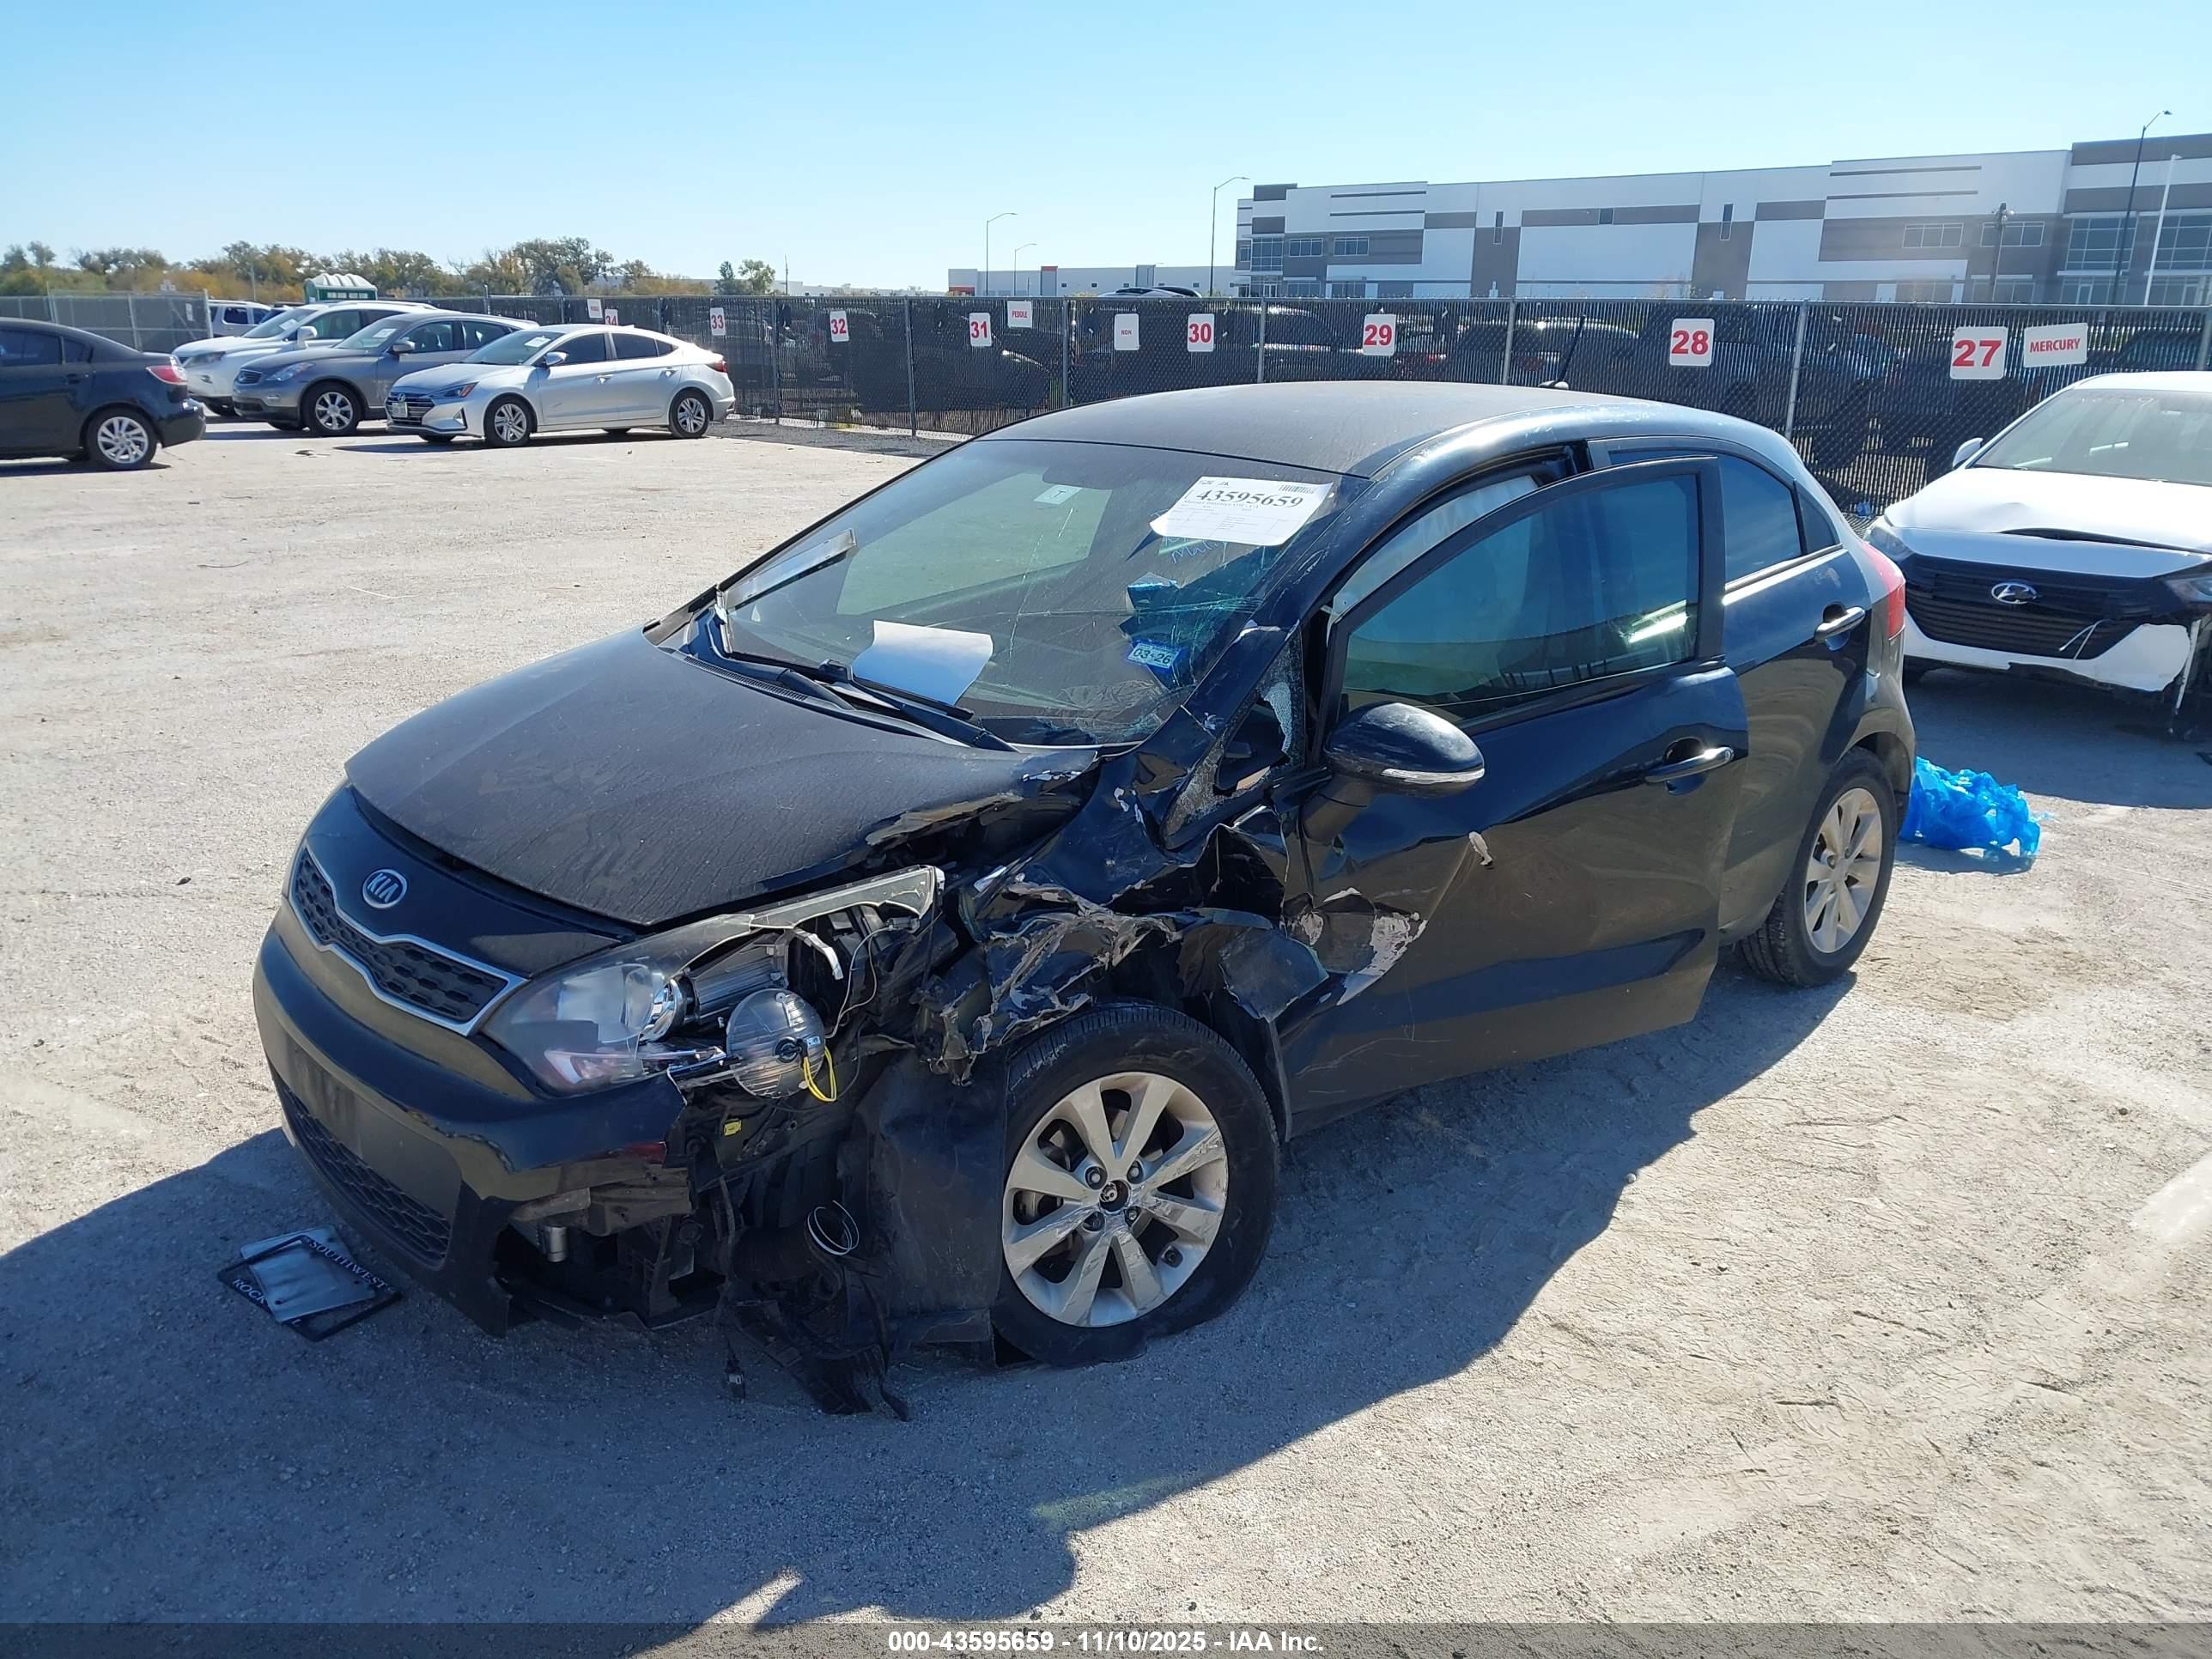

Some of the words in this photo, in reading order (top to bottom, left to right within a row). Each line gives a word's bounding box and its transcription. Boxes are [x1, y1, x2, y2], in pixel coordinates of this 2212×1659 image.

[711, 314, 724, 329] 33
[830, 319, 847, 334] 32
[970, 321, 988, 338] 31
[1188, 323, 1212, 343] 30
[1364, 325, 1392, 345] 29
[1671, 330, 1709, 355] 28
[1952, 339, 2002, 367] 27
[2029, 337, 2081, 353] MERCURY
[1196, 489, 1304, 507] 43595659
[367, 872, 399, 903] KIA
[309, 1239, 388, 1288] SOUTHWEST
